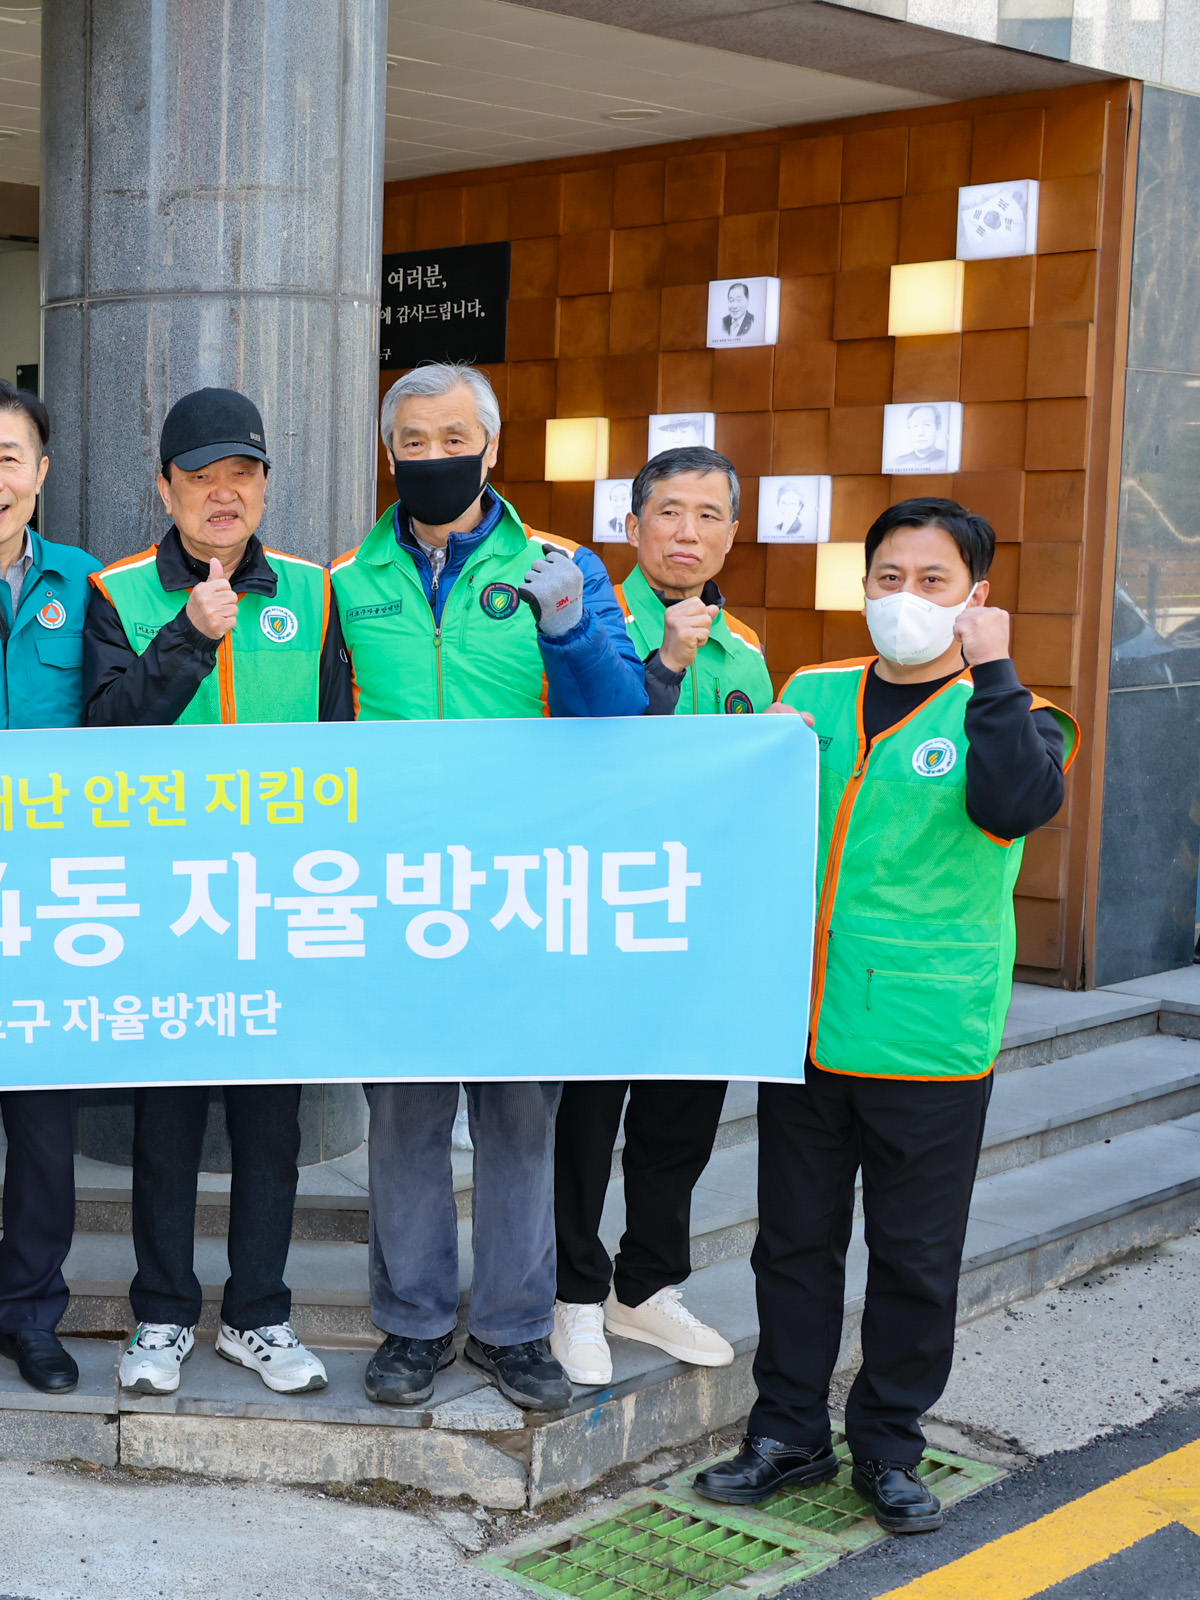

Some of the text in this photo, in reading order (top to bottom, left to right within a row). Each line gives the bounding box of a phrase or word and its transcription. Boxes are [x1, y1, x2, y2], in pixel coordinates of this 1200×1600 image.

[387, 264, 447, 292] 여러분,
[396, 298, 486, 324] 감사드립니다.
[556, 596, 569, 608] 3M
[84, 770, 186, 828] 안전
[205, 767, 357, 825] 지킴이
[169, 841, 702, 961] 자율방재단
[62, 989, 282, 1042] 자율방재단
